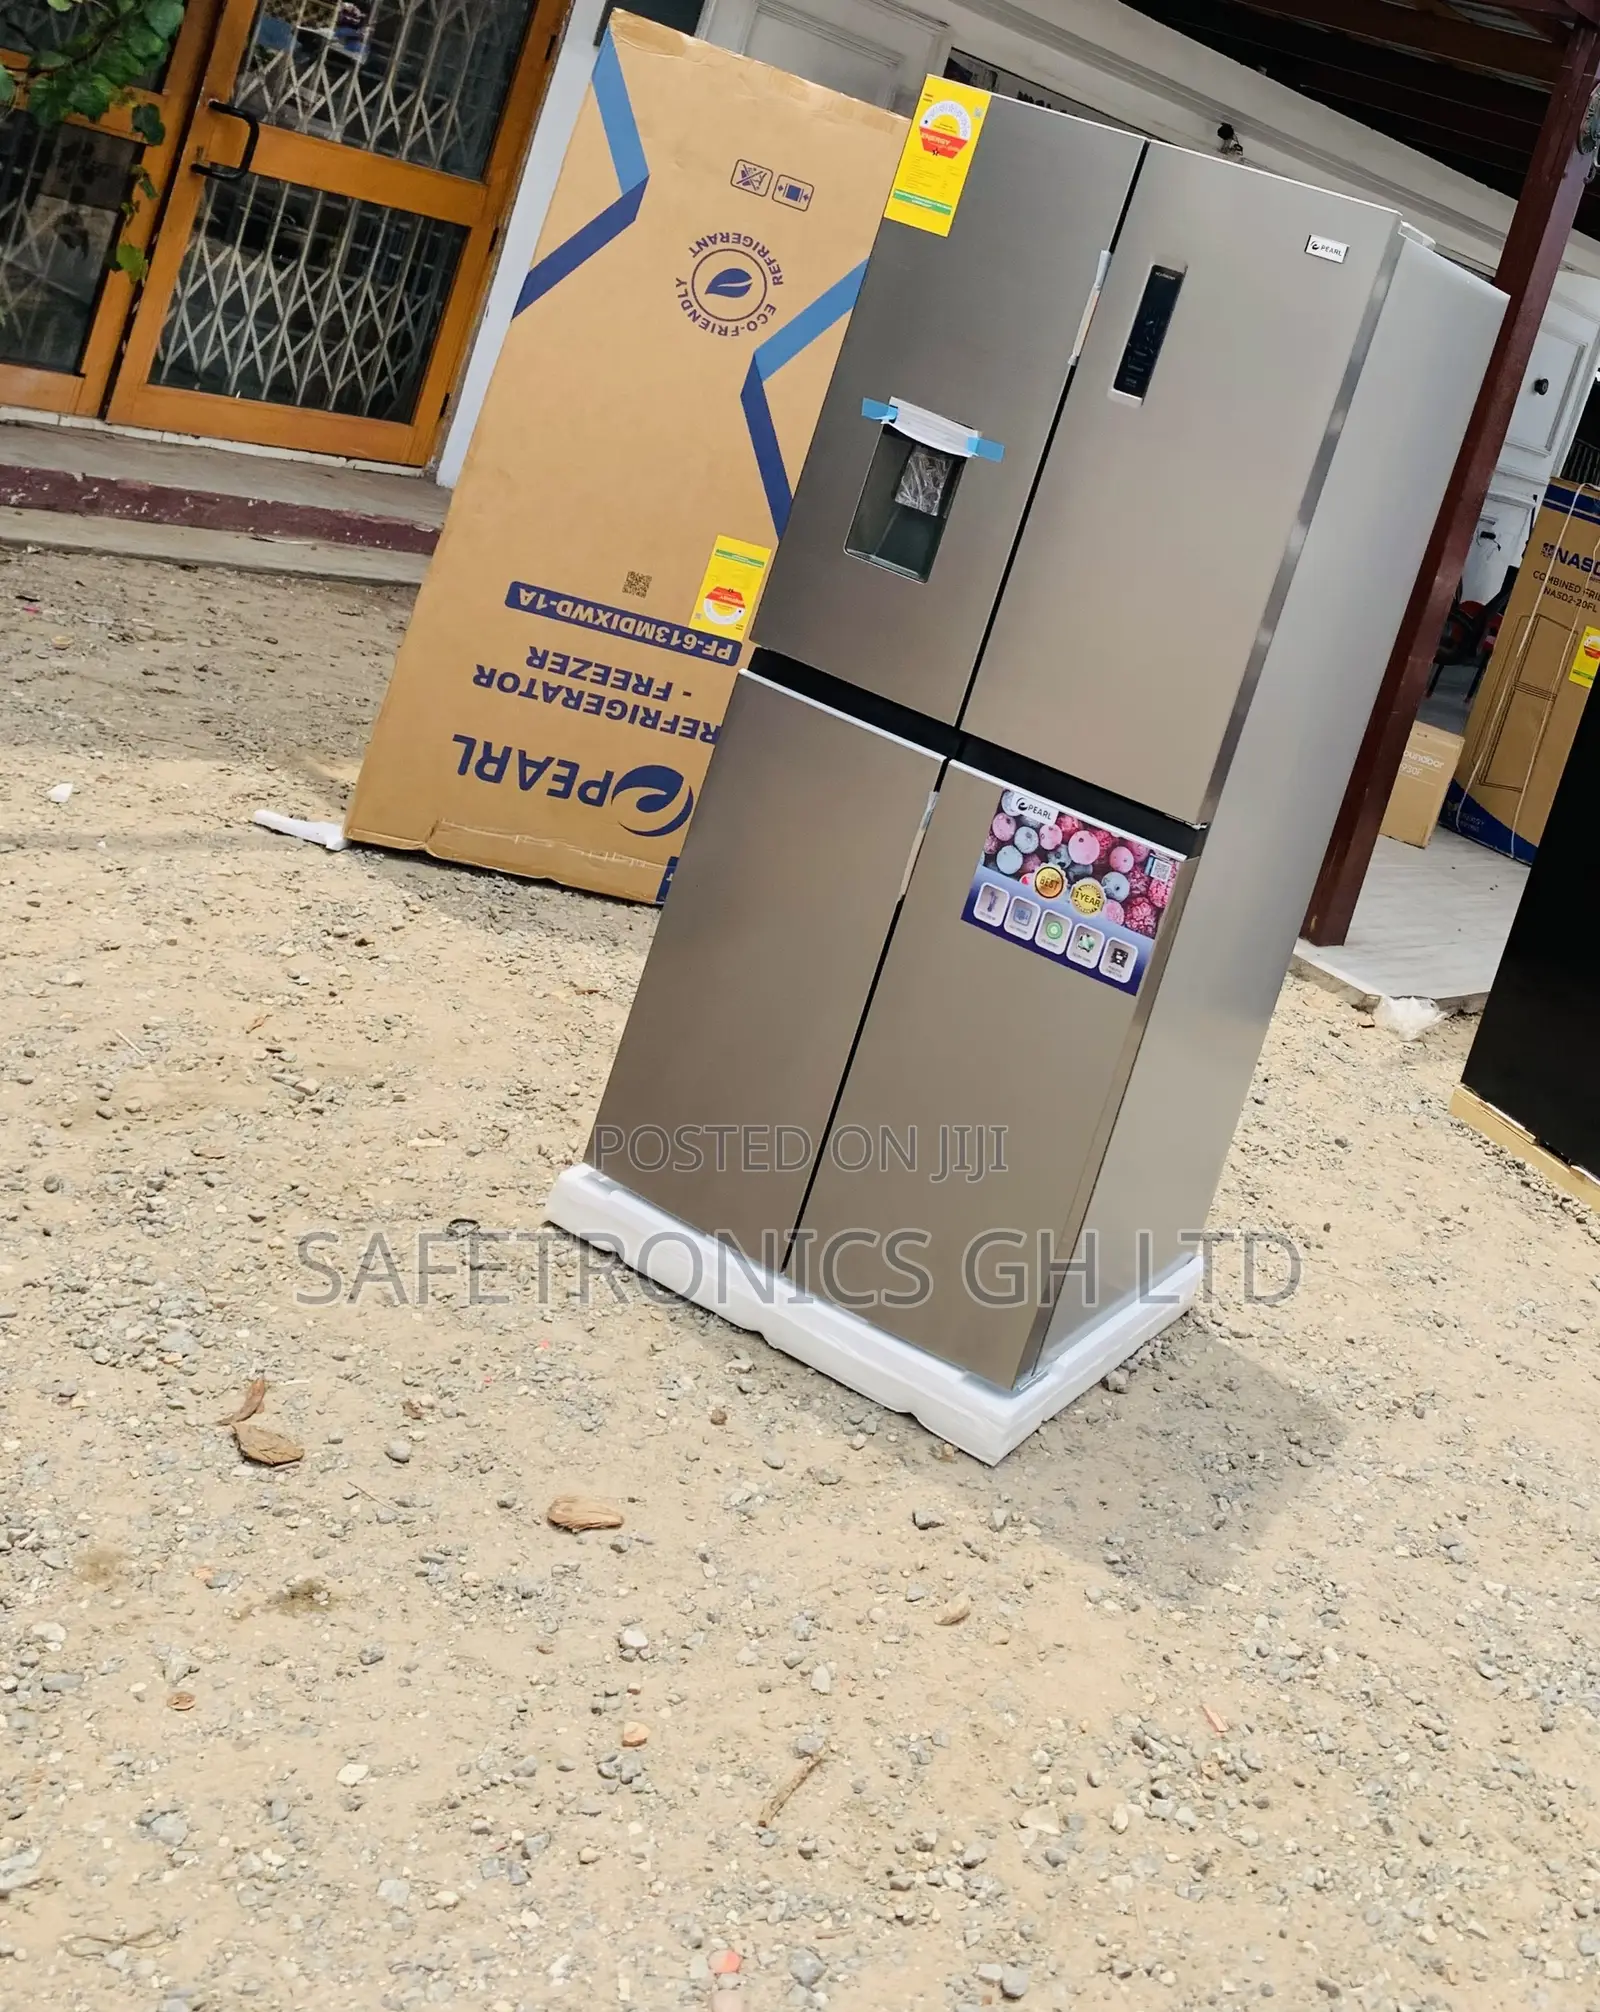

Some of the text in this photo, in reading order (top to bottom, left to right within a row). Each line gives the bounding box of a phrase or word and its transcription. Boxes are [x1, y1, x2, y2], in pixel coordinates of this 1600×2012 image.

[688, 232, 784, 286] REFRIGERANT
[1320, 244, 1342, 257] PEARL
[675, 277, 777, 337] ECO-FRIENDLY
[1533, 570, 1581, 594] COMBINED
[517, 586, 734, 662] PF-613MDIXWD-1A
[525, 645, 674, 702] FREEZER
[472, 664, 723, 745] REFRIGERATOR
[452, 733, 615, 808] PEARL
[1400, 762, 1422, 776] 930F
[1403, 749, 1444, 769] oundbar
[1027, 802, 1053, 820] PEARL
[1040, 875, 1060, 890] BEST
[1075, 890, 1080, 900] 1
[1080, 892, 1101, 908] YEAR
